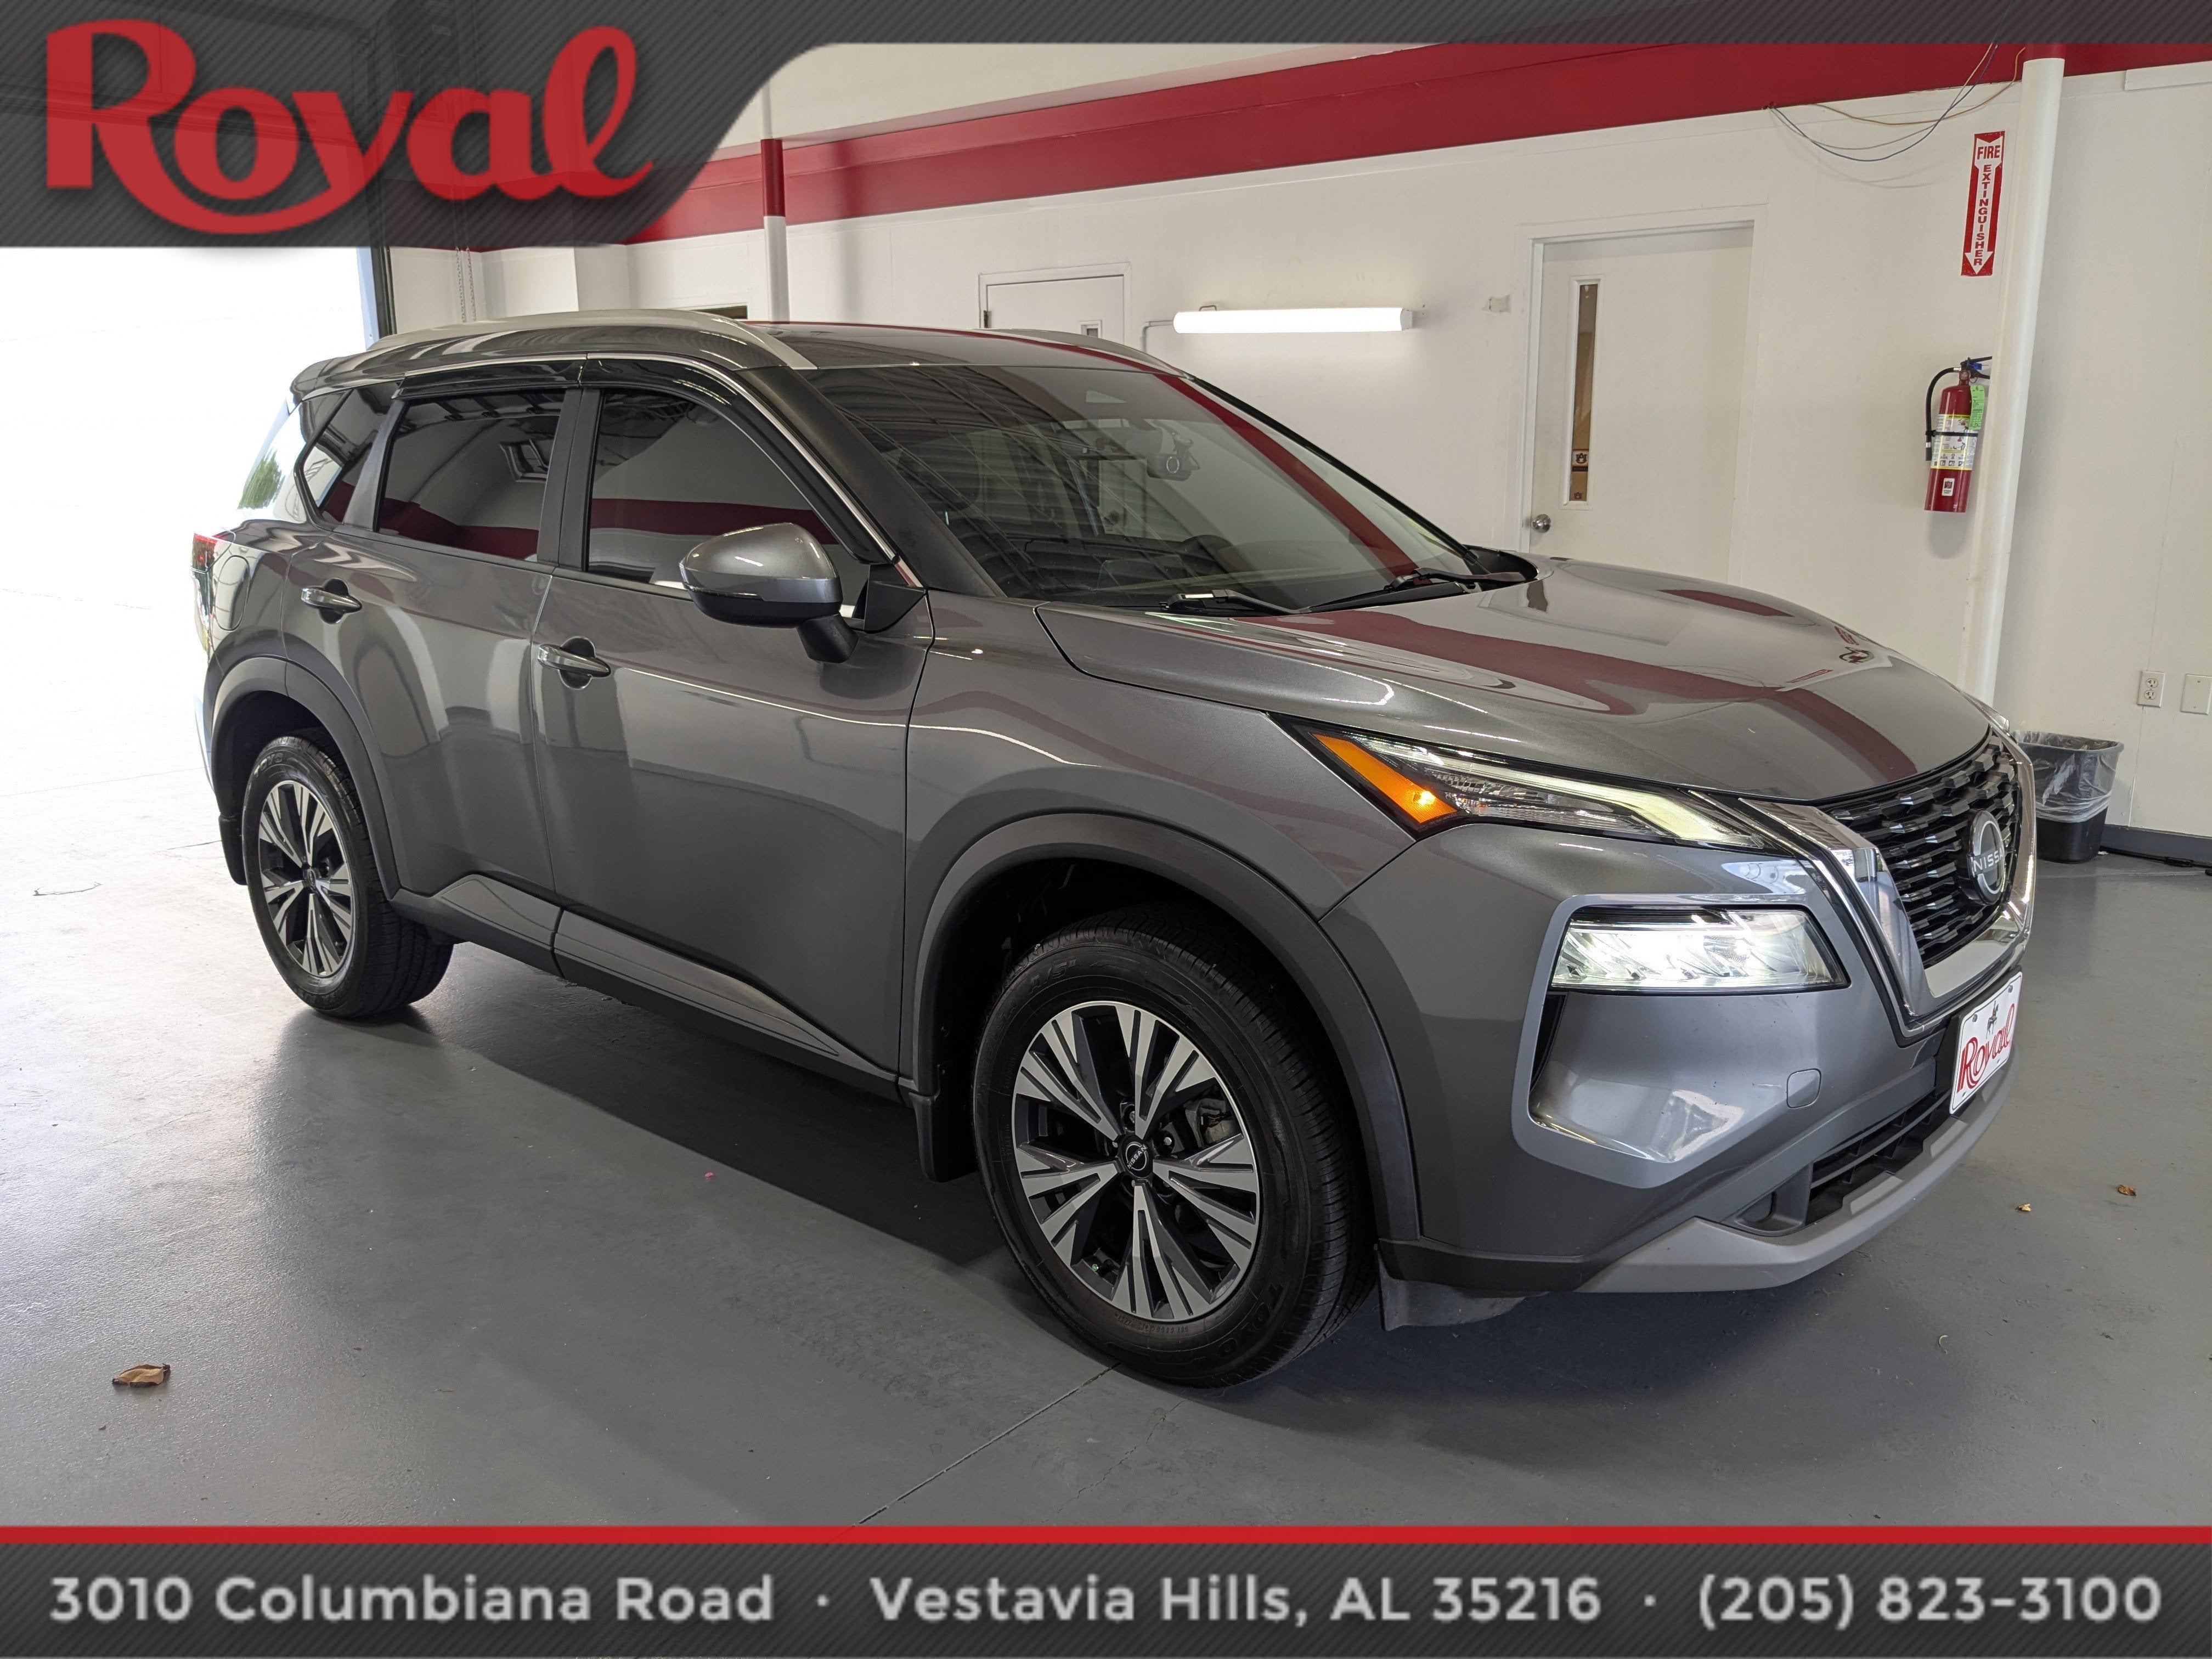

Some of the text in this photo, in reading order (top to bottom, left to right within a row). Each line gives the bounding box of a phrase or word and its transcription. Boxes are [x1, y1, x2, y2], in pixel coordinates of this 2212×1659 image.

[1977, 144, 2001, 160] FIRE
[1973, 164, 1992, 266] EXTINGUISHER
[1973, 847, 2004, 873] NISSA
[1956, 1003, 2016, 1093] Royal
[1127, 1143, 1148, 1169] NISSAN
